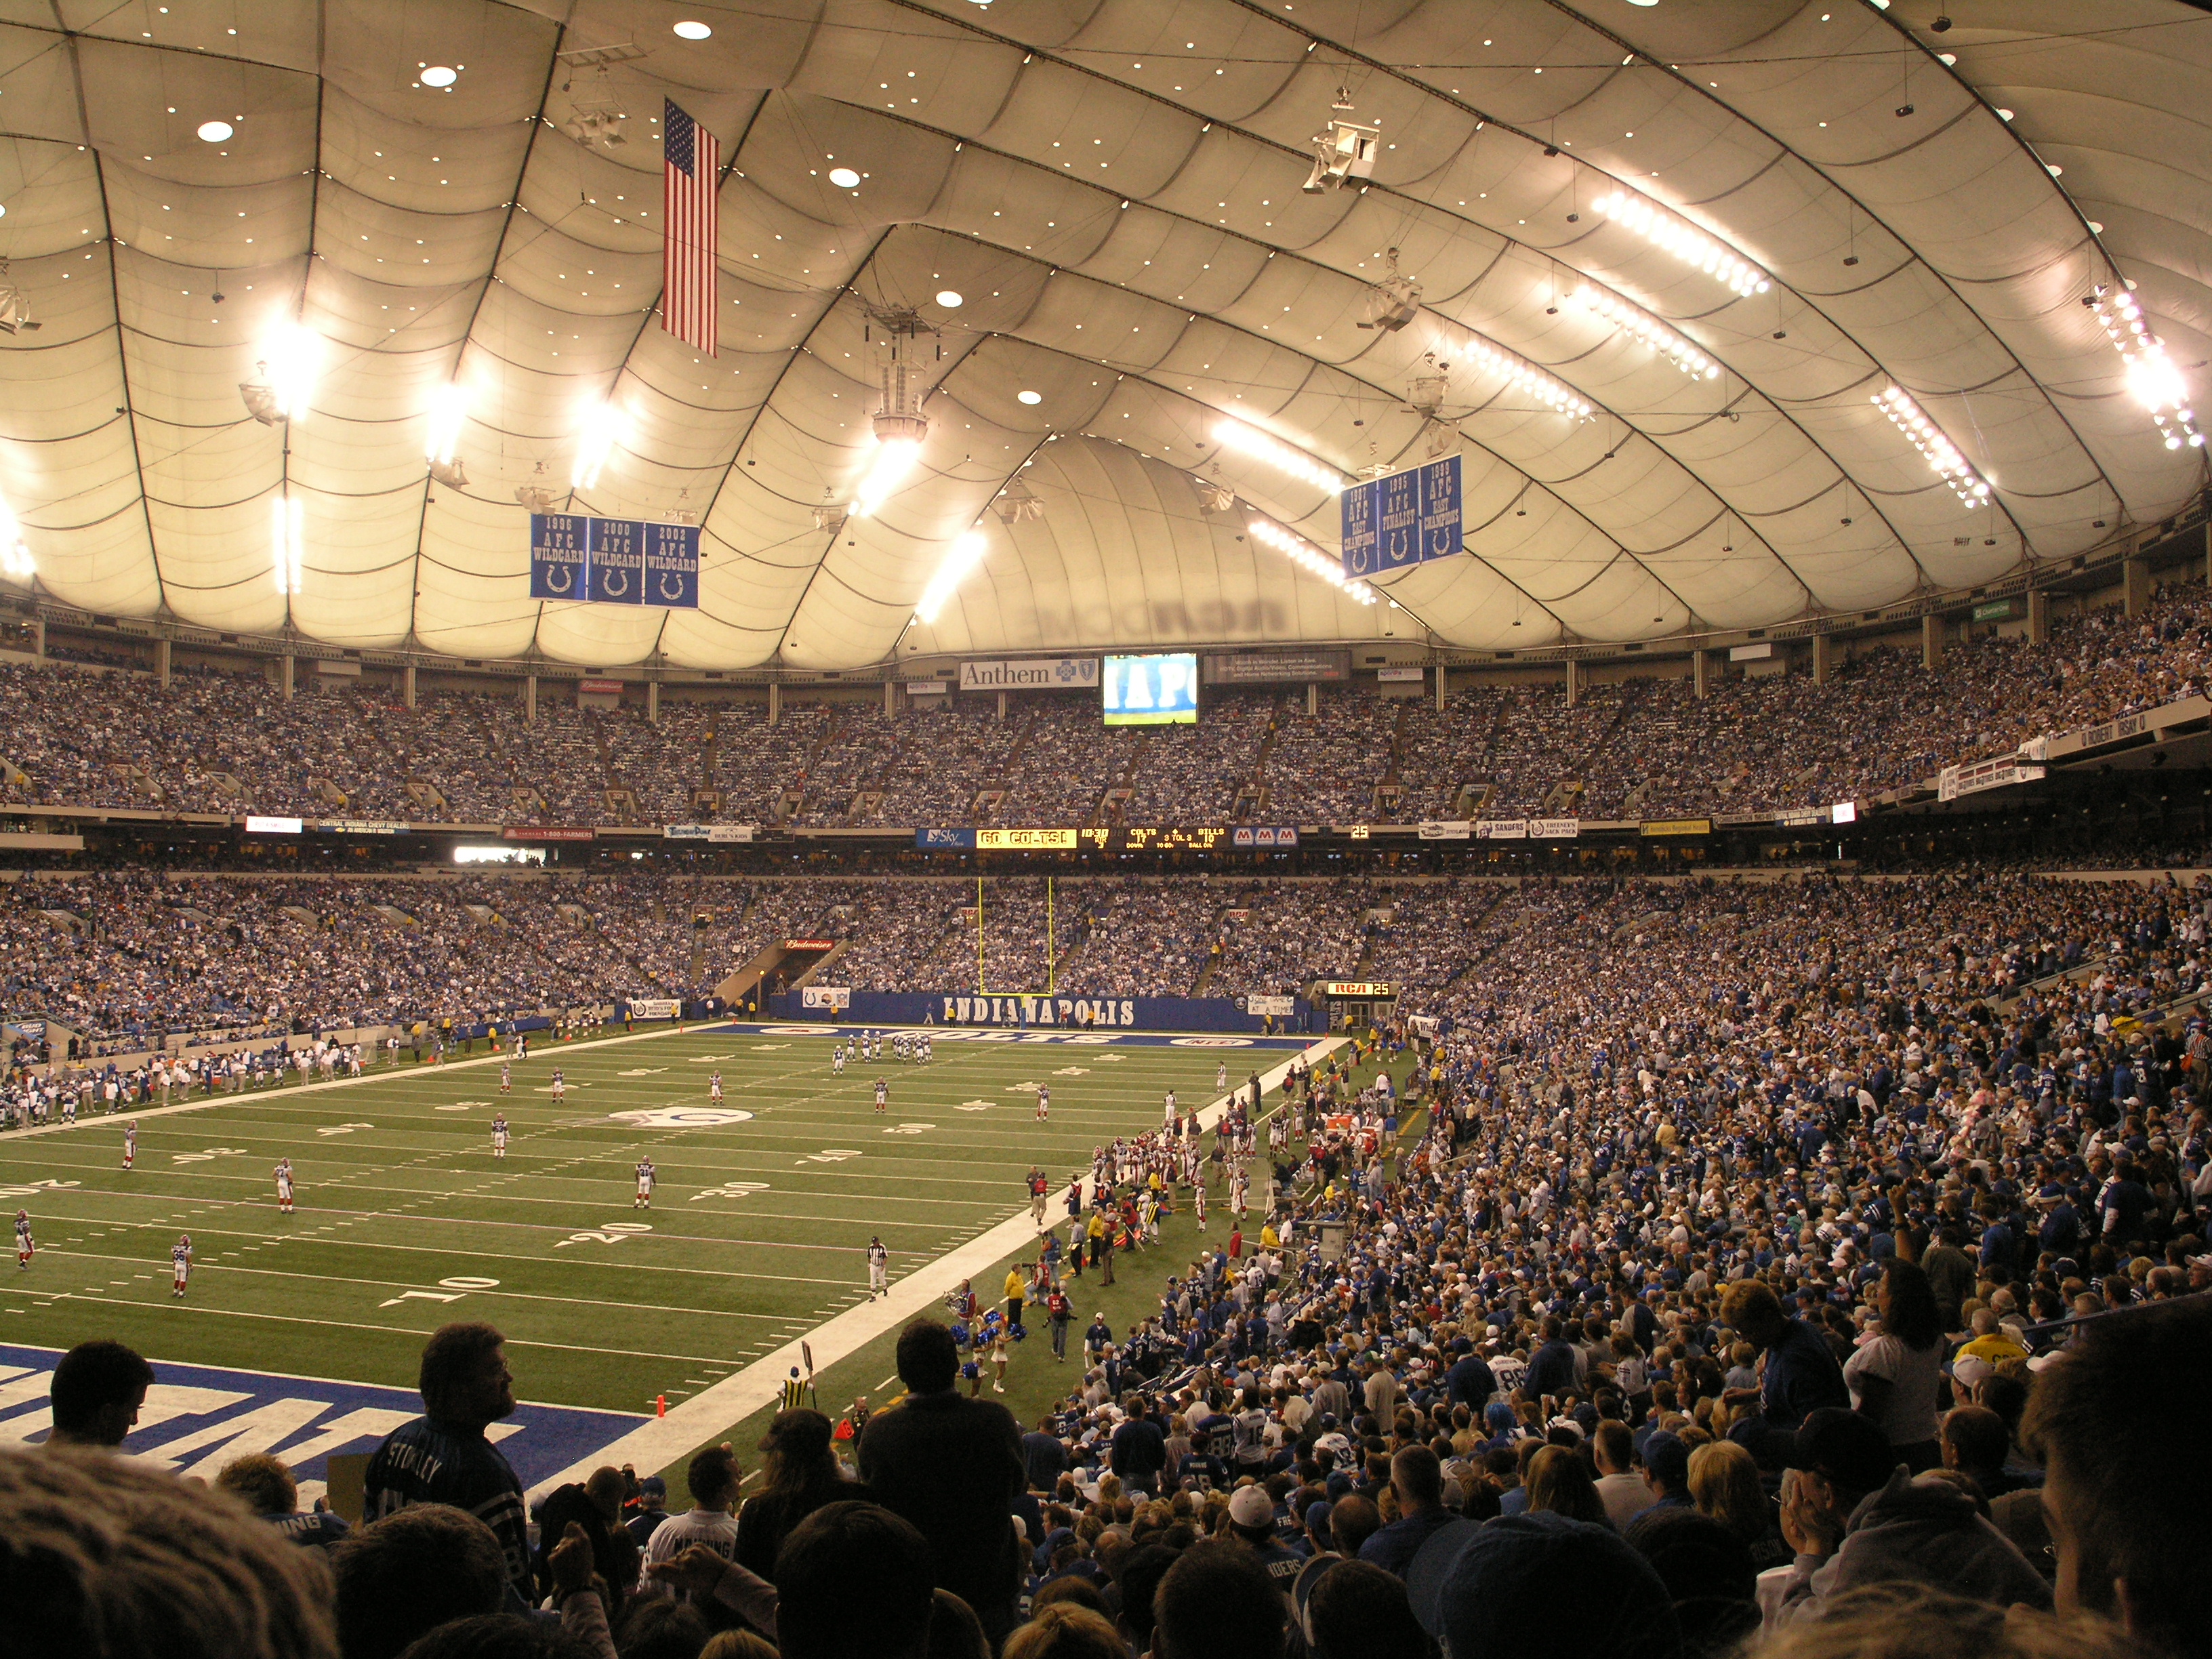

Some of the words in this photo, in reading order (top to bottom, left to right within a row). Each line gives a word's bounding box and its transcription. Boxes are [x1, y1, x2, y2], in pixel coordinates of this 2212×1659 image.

[1431, 462, 1450, 480] 1999
[546, 516, 572, 531] 1996
[1382, 508, 1416, 531] FINALIST
[1425, 508, 1459, 531] CHAMPIONS
[604, 522, 630, 537] 2000
[659, 527, 686, 541] 2002
[533, 547, 584, 564] WILDCARD
[592, 551, 642, 569] WILDCARD
[647, 556, 696, 572] WILDCARD
[964, 662, 1050, 684] Anthem
[1081, 829, 1109, 838] 10:30
[1352, 825, 1368, 838] 25
[1495, 823, 1524, 831] SANDERS
[940, 830, 960, 846] Sky
[981, 832, 1002, 845] GO
[1009, 832, 1067, 845] COLTS!
[1136, 835, 1147, 843] 17
[1204, 835, 1214, 843] 10
[786, 939, 832, 949] Budweiser
[1335, 984, 1366, 994] RCA
[1374, 983, 1389, 995] 25
[943, 996, 1134, 1025] INDIANAPOLIS
[882, 1123, 937, 1134] 50
[806, 1149, 863, 1162] 40
[699, 1182, 770, 1197] 30
[568, 1223, 653, 1244] 20
[398, 1277, 500, 1303] 10
[1277, 1515, 1292, 1527] FRE
